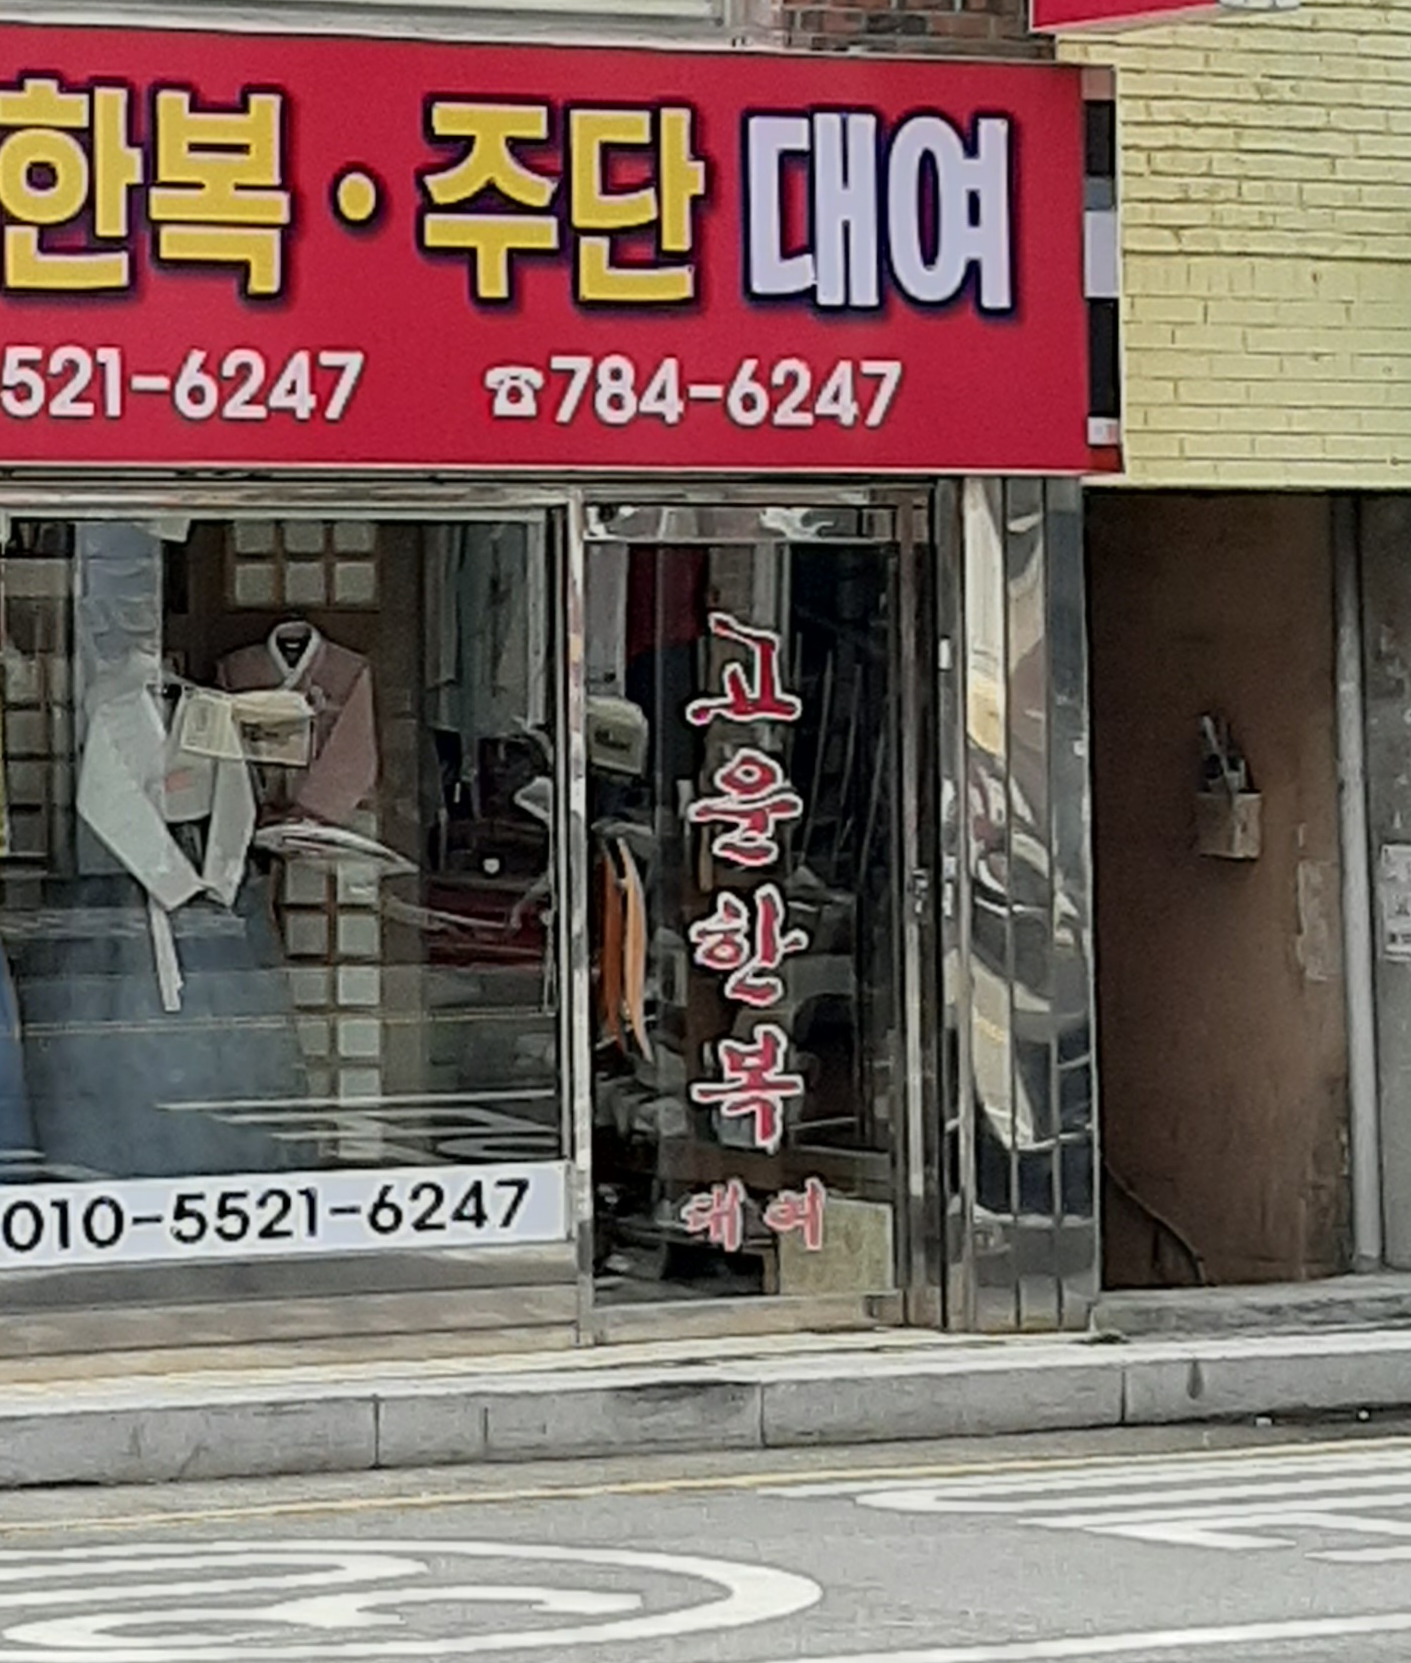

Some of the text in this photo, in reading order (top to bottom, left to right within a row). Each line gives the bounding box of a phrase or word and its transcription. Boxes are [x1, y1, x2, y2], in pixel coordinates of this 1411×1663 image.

[421, 99, 707, 305] 주단
[744, 109, 1015, 312] 대여
[548, 355, 905, 428] 784-6247
[0, 1177, 532, 1252] 010-5521-6247
